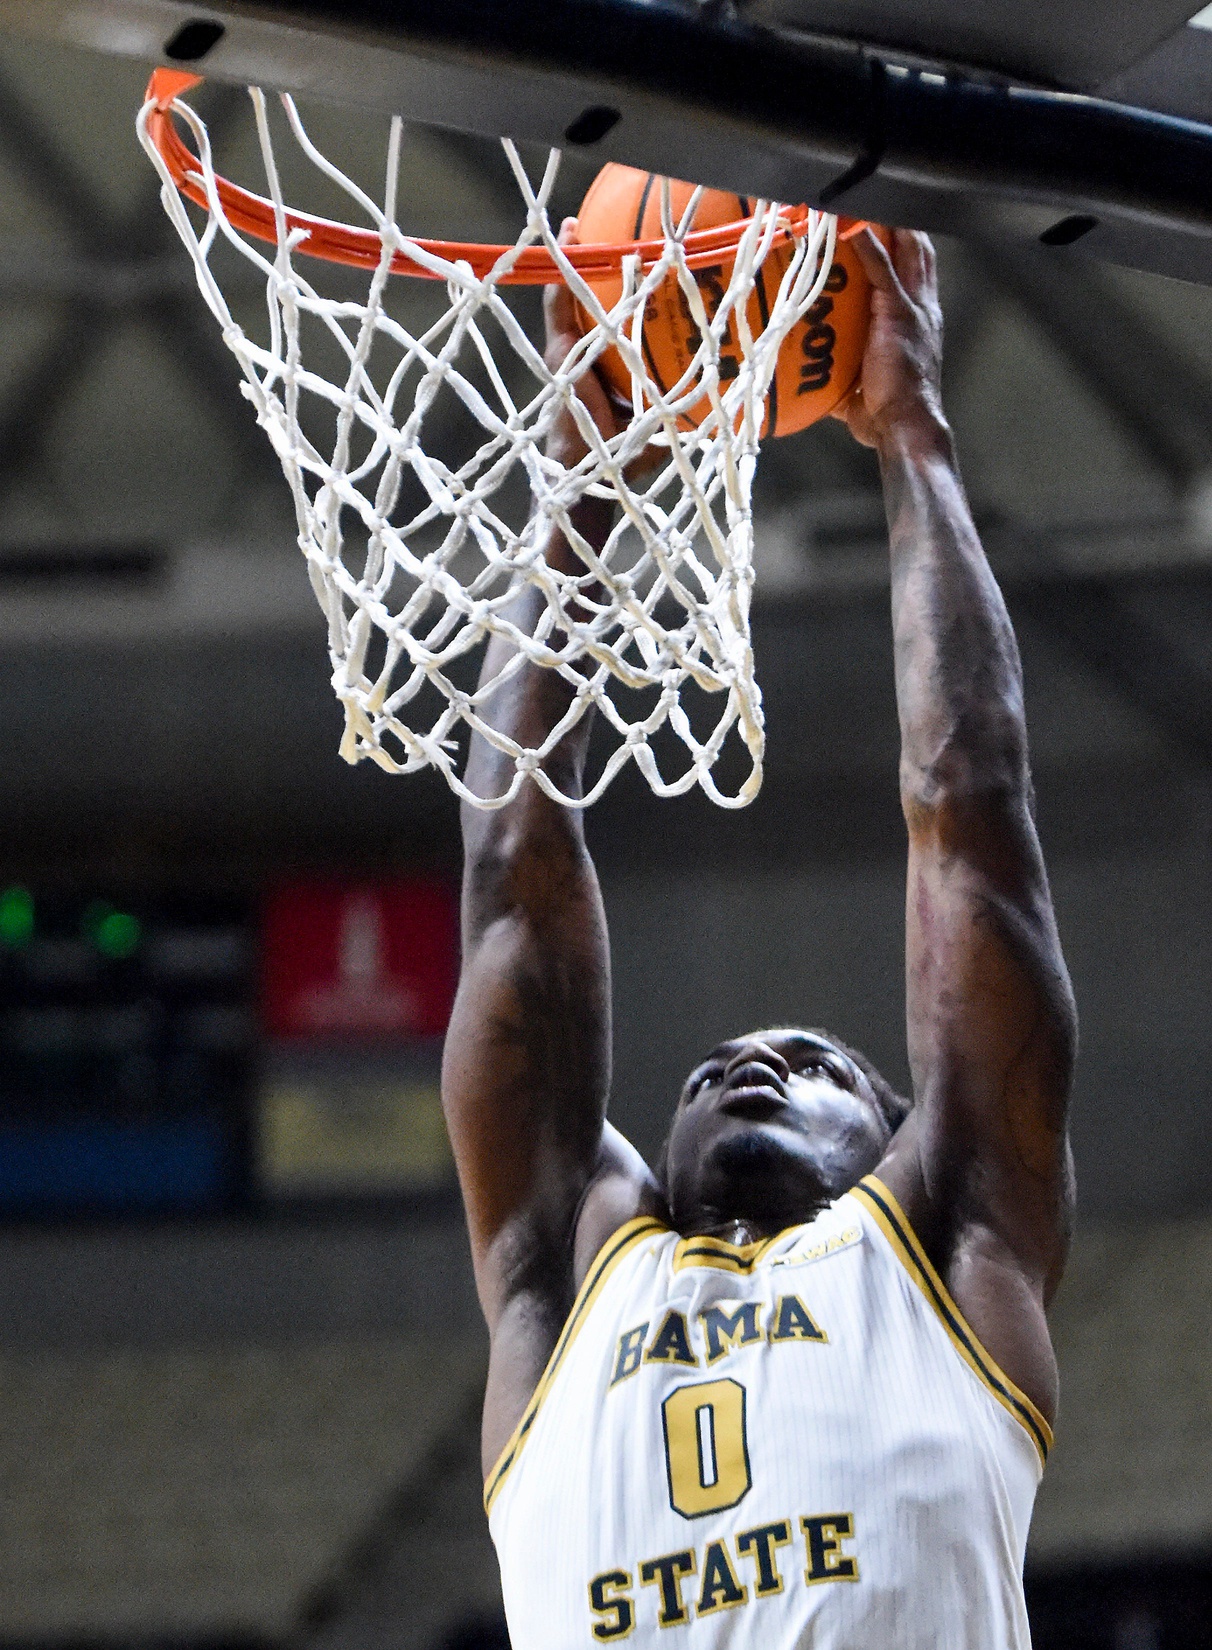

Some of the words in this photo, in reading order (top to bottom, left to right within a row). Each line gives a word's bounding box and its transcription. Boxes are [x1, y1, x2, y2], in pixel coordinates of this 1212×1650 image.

[794, 238, 848, 396] lson
[608, 1294, 829, 1389] BAMA
[661, 1377, 752, 1521] 0
[588, 1511, 860, 1643] STATE
